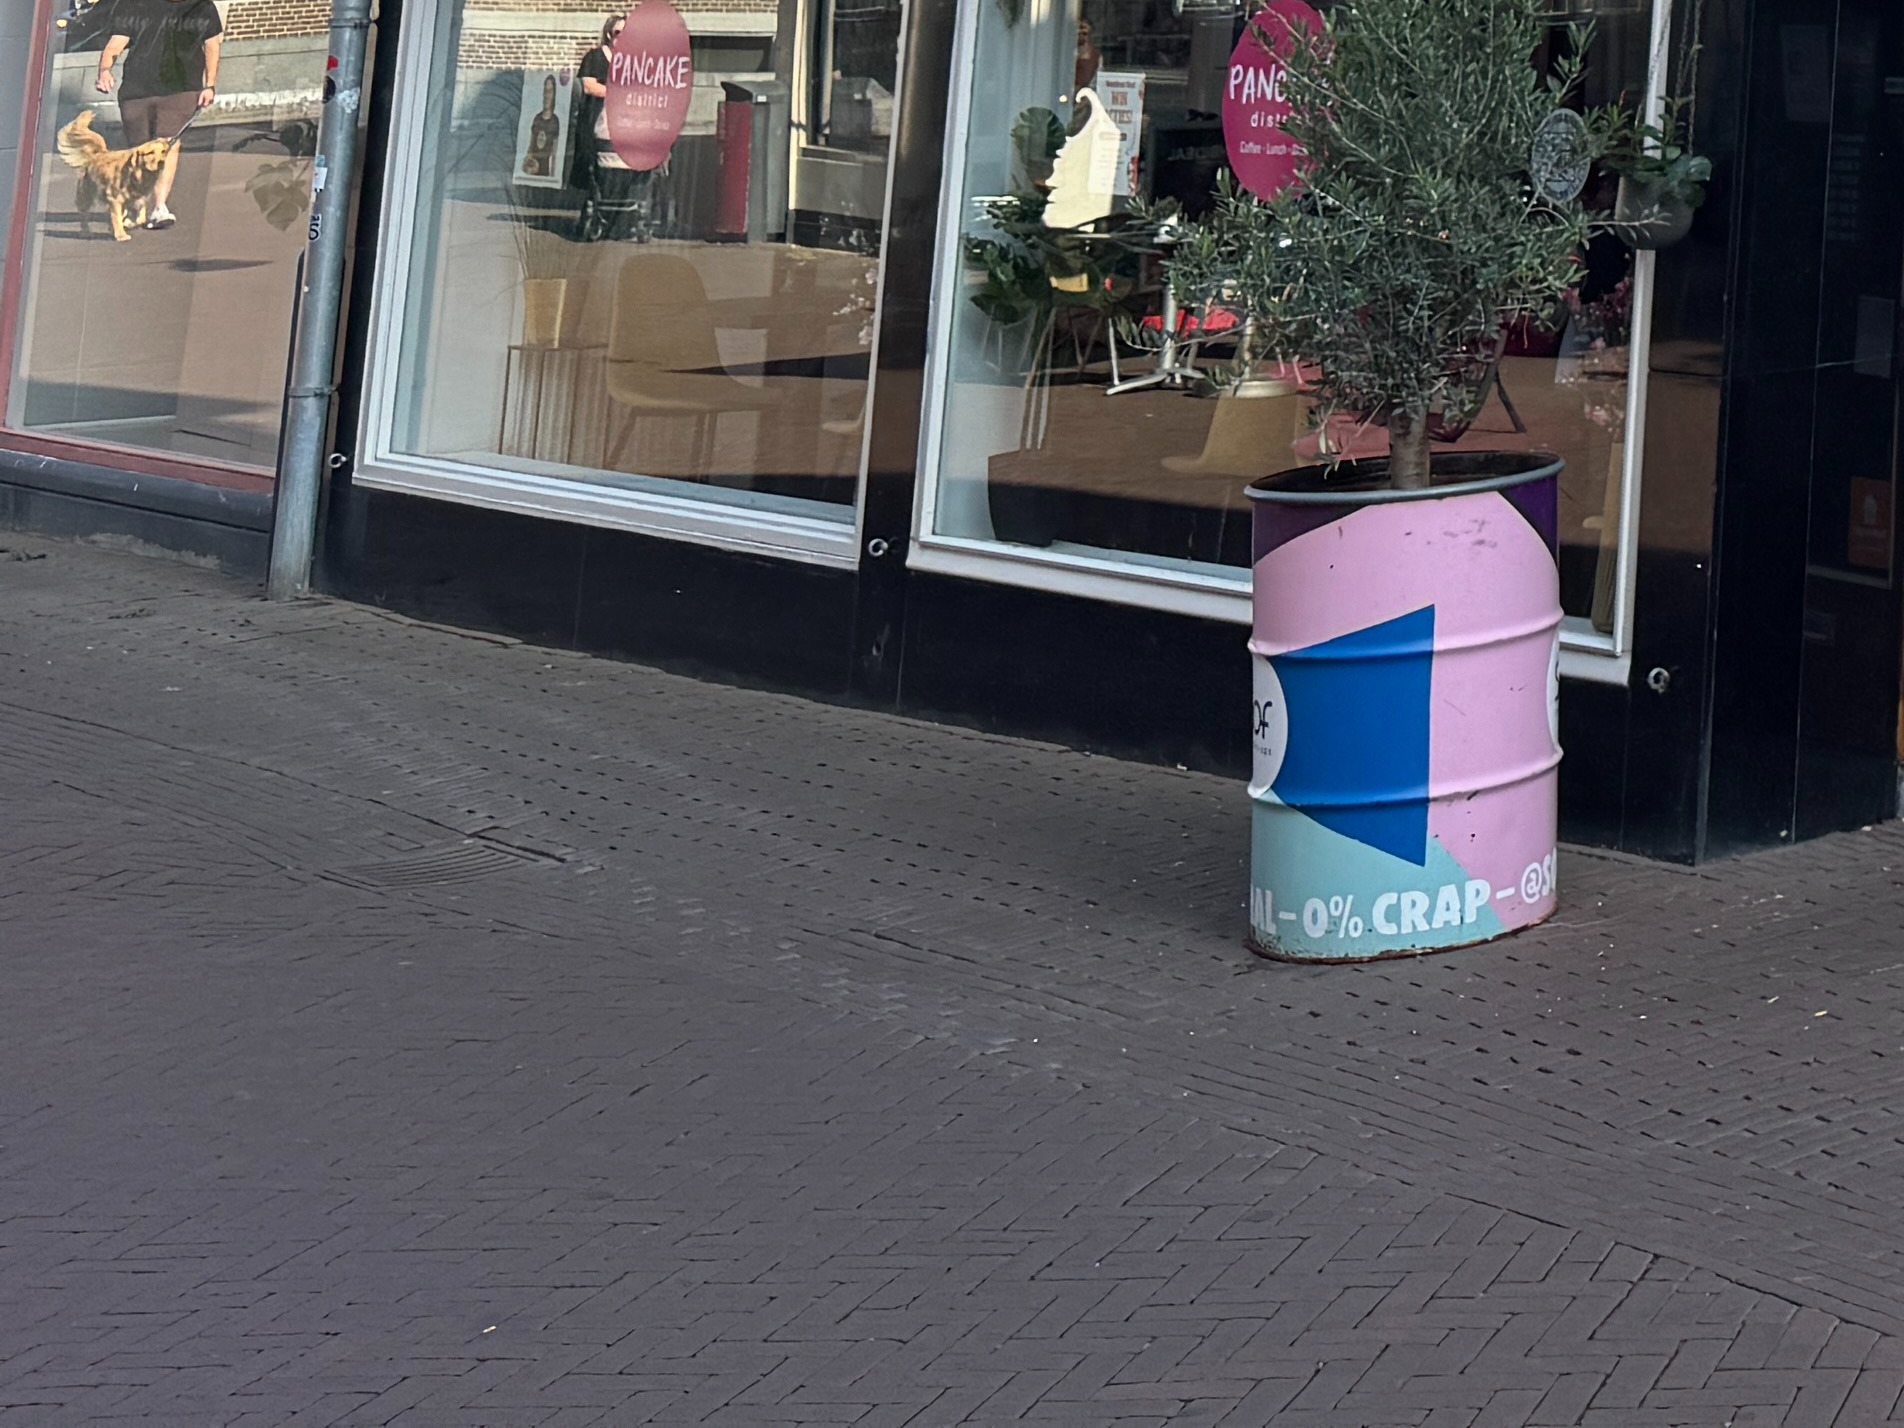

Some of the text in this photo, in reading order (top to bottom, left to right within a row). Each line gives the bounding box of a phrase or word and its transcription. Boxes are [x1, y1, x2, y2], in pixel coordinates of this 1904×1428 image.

[612, 50, 690, 89] PANCAKE
[1230, 64, 1287, 104] PANC
[626, 93, 668, 108] district
[1303, 895, 1363, 938] 0%
[1372, 879, 1490, 935] CRAP
